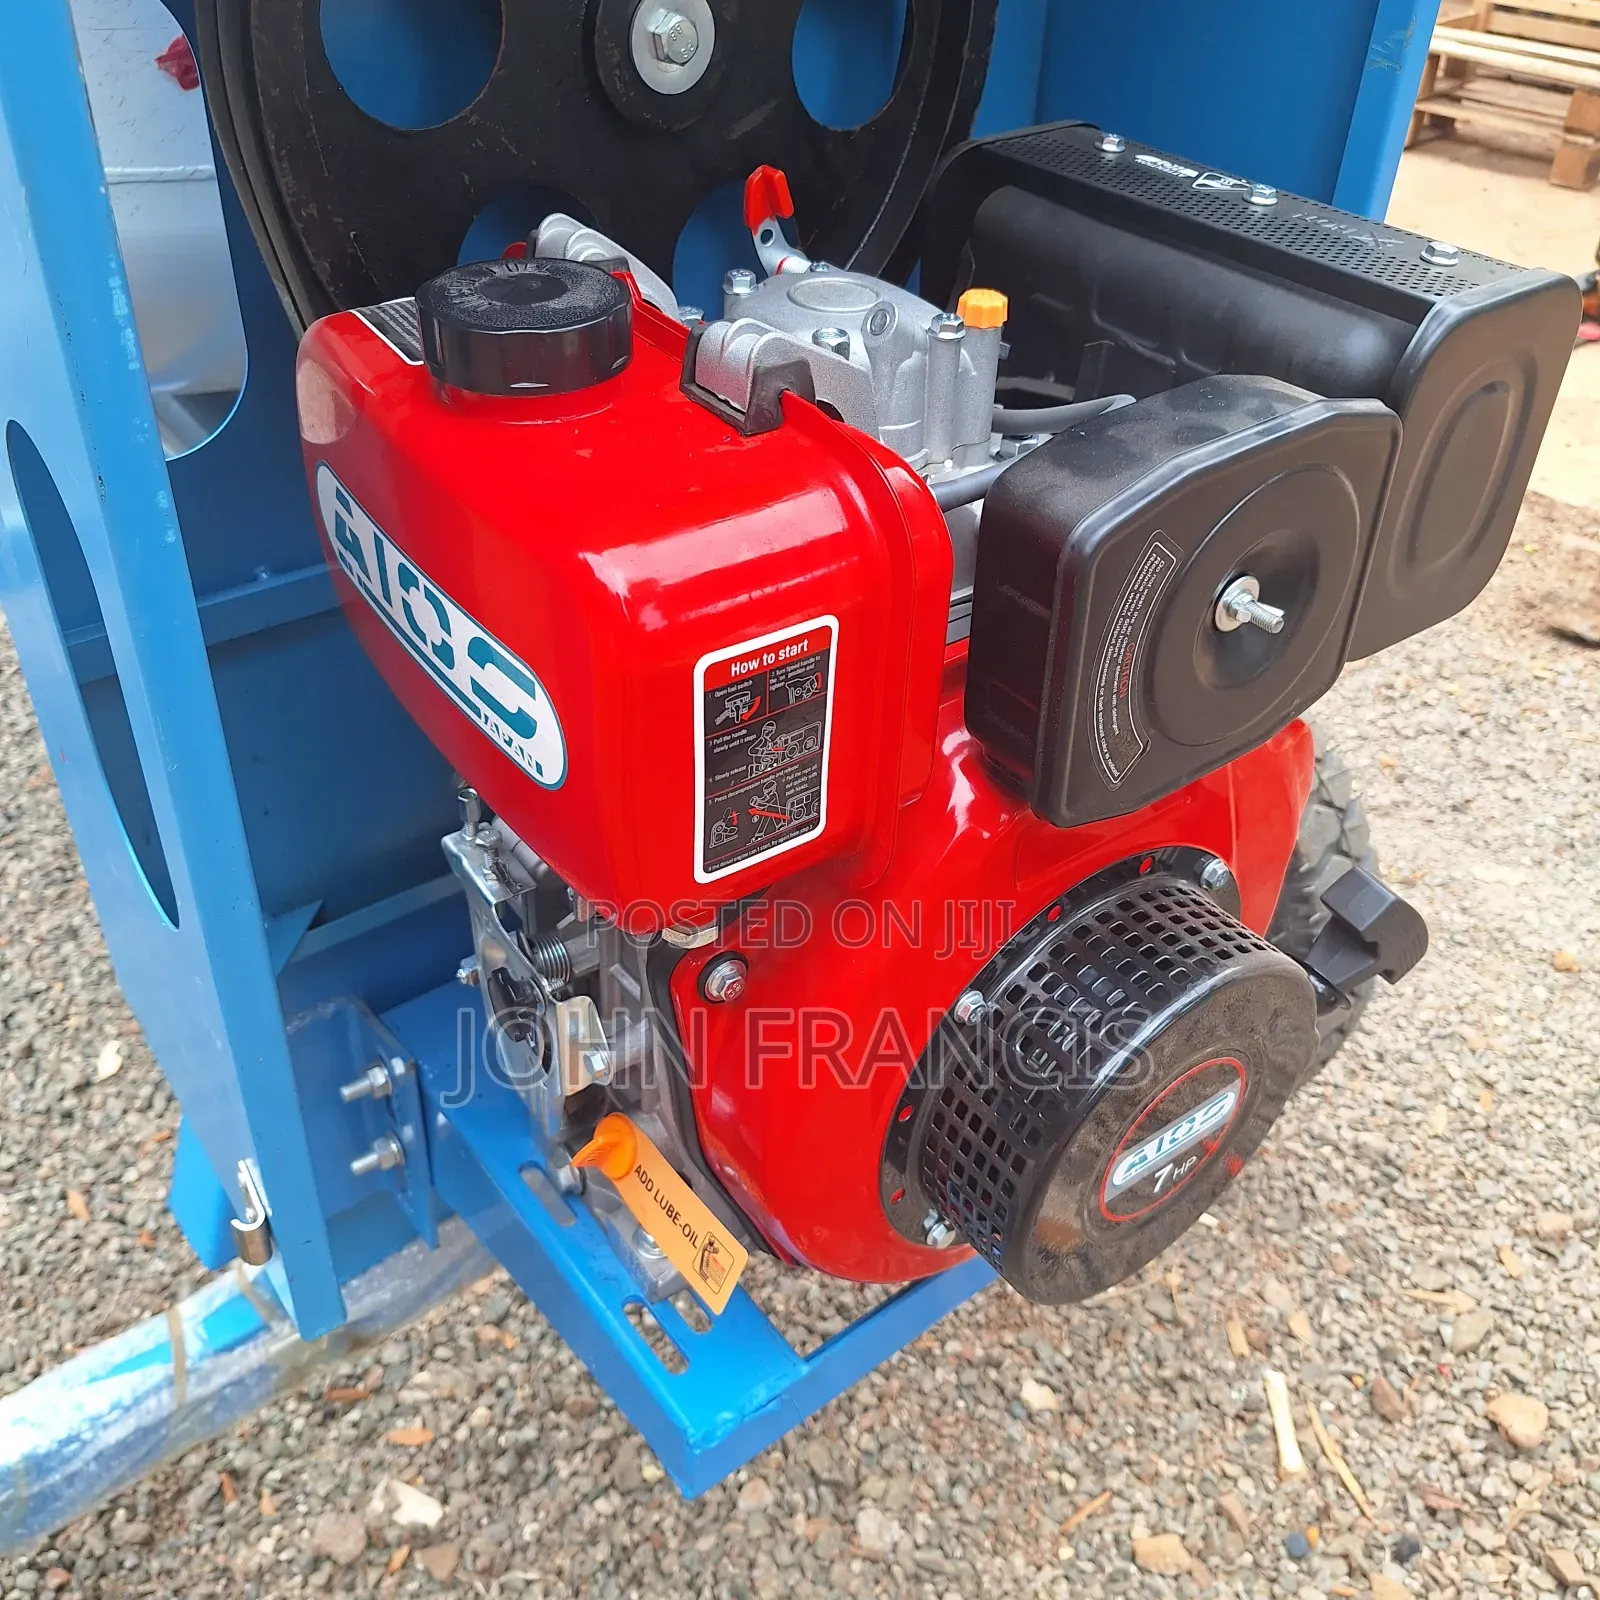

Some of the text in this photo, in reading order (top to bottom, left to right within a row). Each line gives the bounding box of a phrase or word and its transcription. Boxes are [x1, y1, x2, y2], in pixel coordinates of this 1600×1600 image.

[1134, 552, 1156, 590] Replace
[1139, 556, 1161, 592] Replace
[1156, 560, 1165, 572] Do
[1148, 574, 1157, 587] not
[1121, 592, 1135, 616] when
[1127, 593, 1140, 617] every
[1136, 589, 1149, 610] wash
[1130, 611, 1139, 624] the
[1110, 617, 1123, 645] output
[731, 639, 809, 678] How to start
[1113, 635, 1123, 658] hours
[1117, 637, 1128, 664] cleaner
[806, 663, 815, 671] and
[1101, 645, 1114, 687] decreases
[1119, 642, 1135, 699] CAUTION
[714, 690, 728, 698] Open
[728, 685, 737, 693] fuel
[738, 680, 753, 691] switch
[1112, 665, 1121, 692] element
[481, 709, 543, 778] JAPAN
[713, 737, 723, 746] Pull
[732, 729, 748, 738] handle
[713, 745, 729, 754] slowly
[729, 740, 740, 748] until
[744, 734, 757, 743] stops
[714, 771, 730, 782] Slowly
[730, 765, 747, 775] release
[1108, 758, 1120, 777] noticed
[714, 795, 728, 803] Press
[728, 781, 760, 798] decompression
[760, 774, 776, 784] handle
[720, 858, 734, 867] diesel
[733, 852, 749, 862] engine
[1153, 1155, 1198, 1193] 7 HP
[634, 1163, 700, 1250] ADD LUBE-OIL
